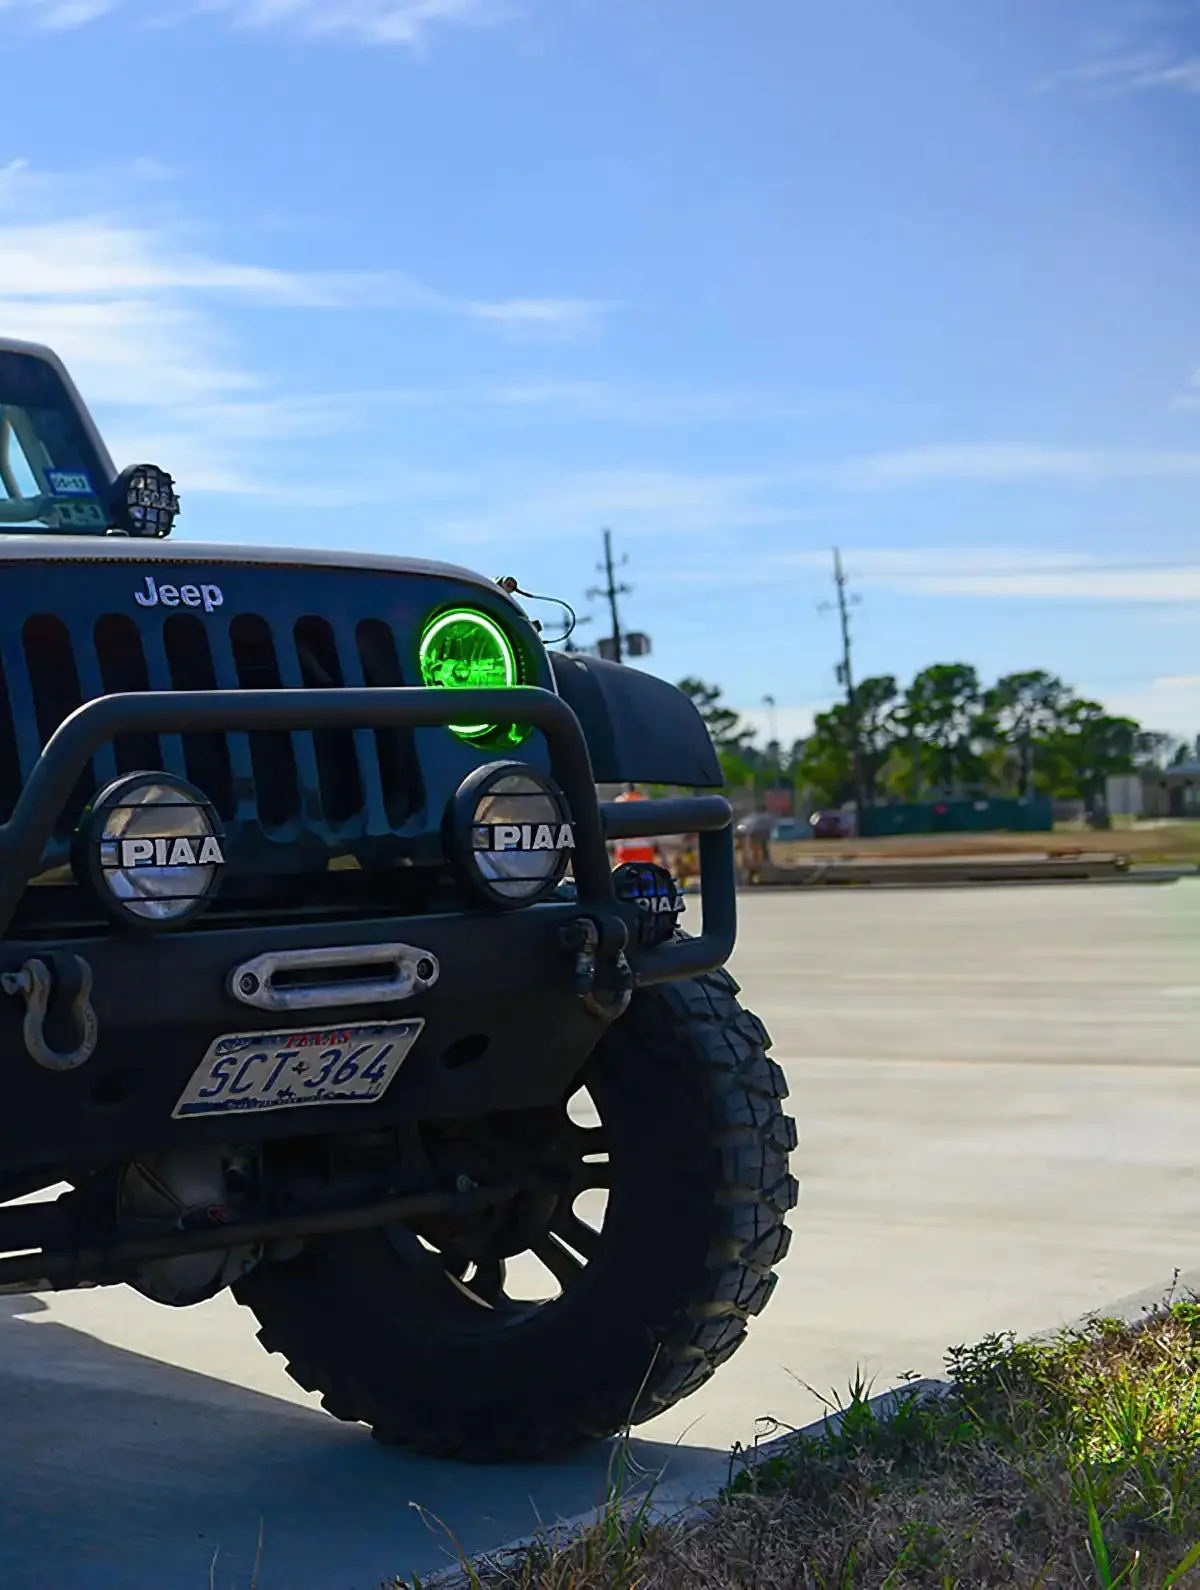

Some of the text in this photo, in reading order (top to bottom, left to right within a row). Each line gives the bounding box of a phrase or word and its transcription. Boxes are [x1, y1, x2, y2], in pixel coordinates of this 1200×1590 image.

[134, 576, 224, 612] Jeep
[121, 836, 226, 867] PIAA
[493, 823, 577, 851] PIAA
